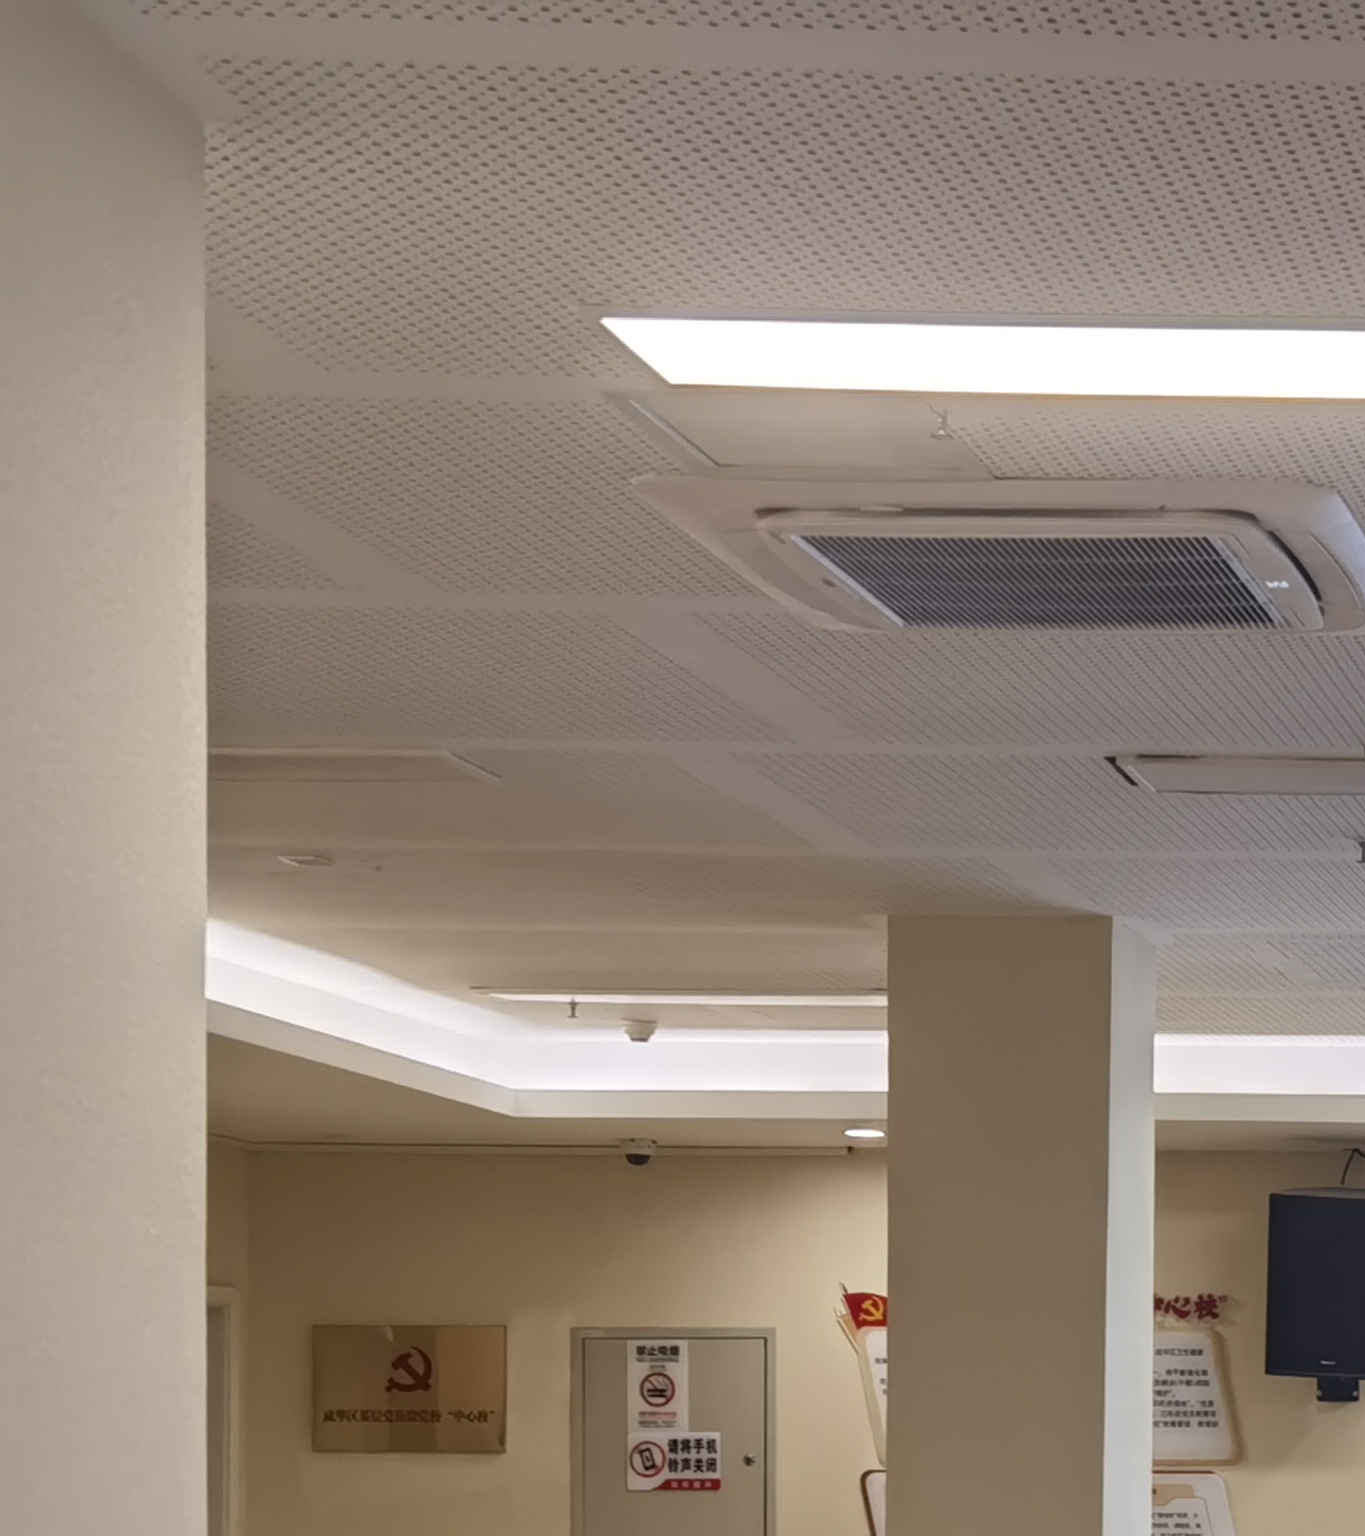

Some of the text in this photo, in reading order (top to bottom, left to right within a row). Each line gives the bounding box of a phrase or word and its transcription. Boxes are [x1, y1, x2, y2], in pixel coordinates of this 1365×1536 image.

[667, 1438, 718, 1455] 请将手机
[667, 1457, 718, 1473] 铃声关闭
